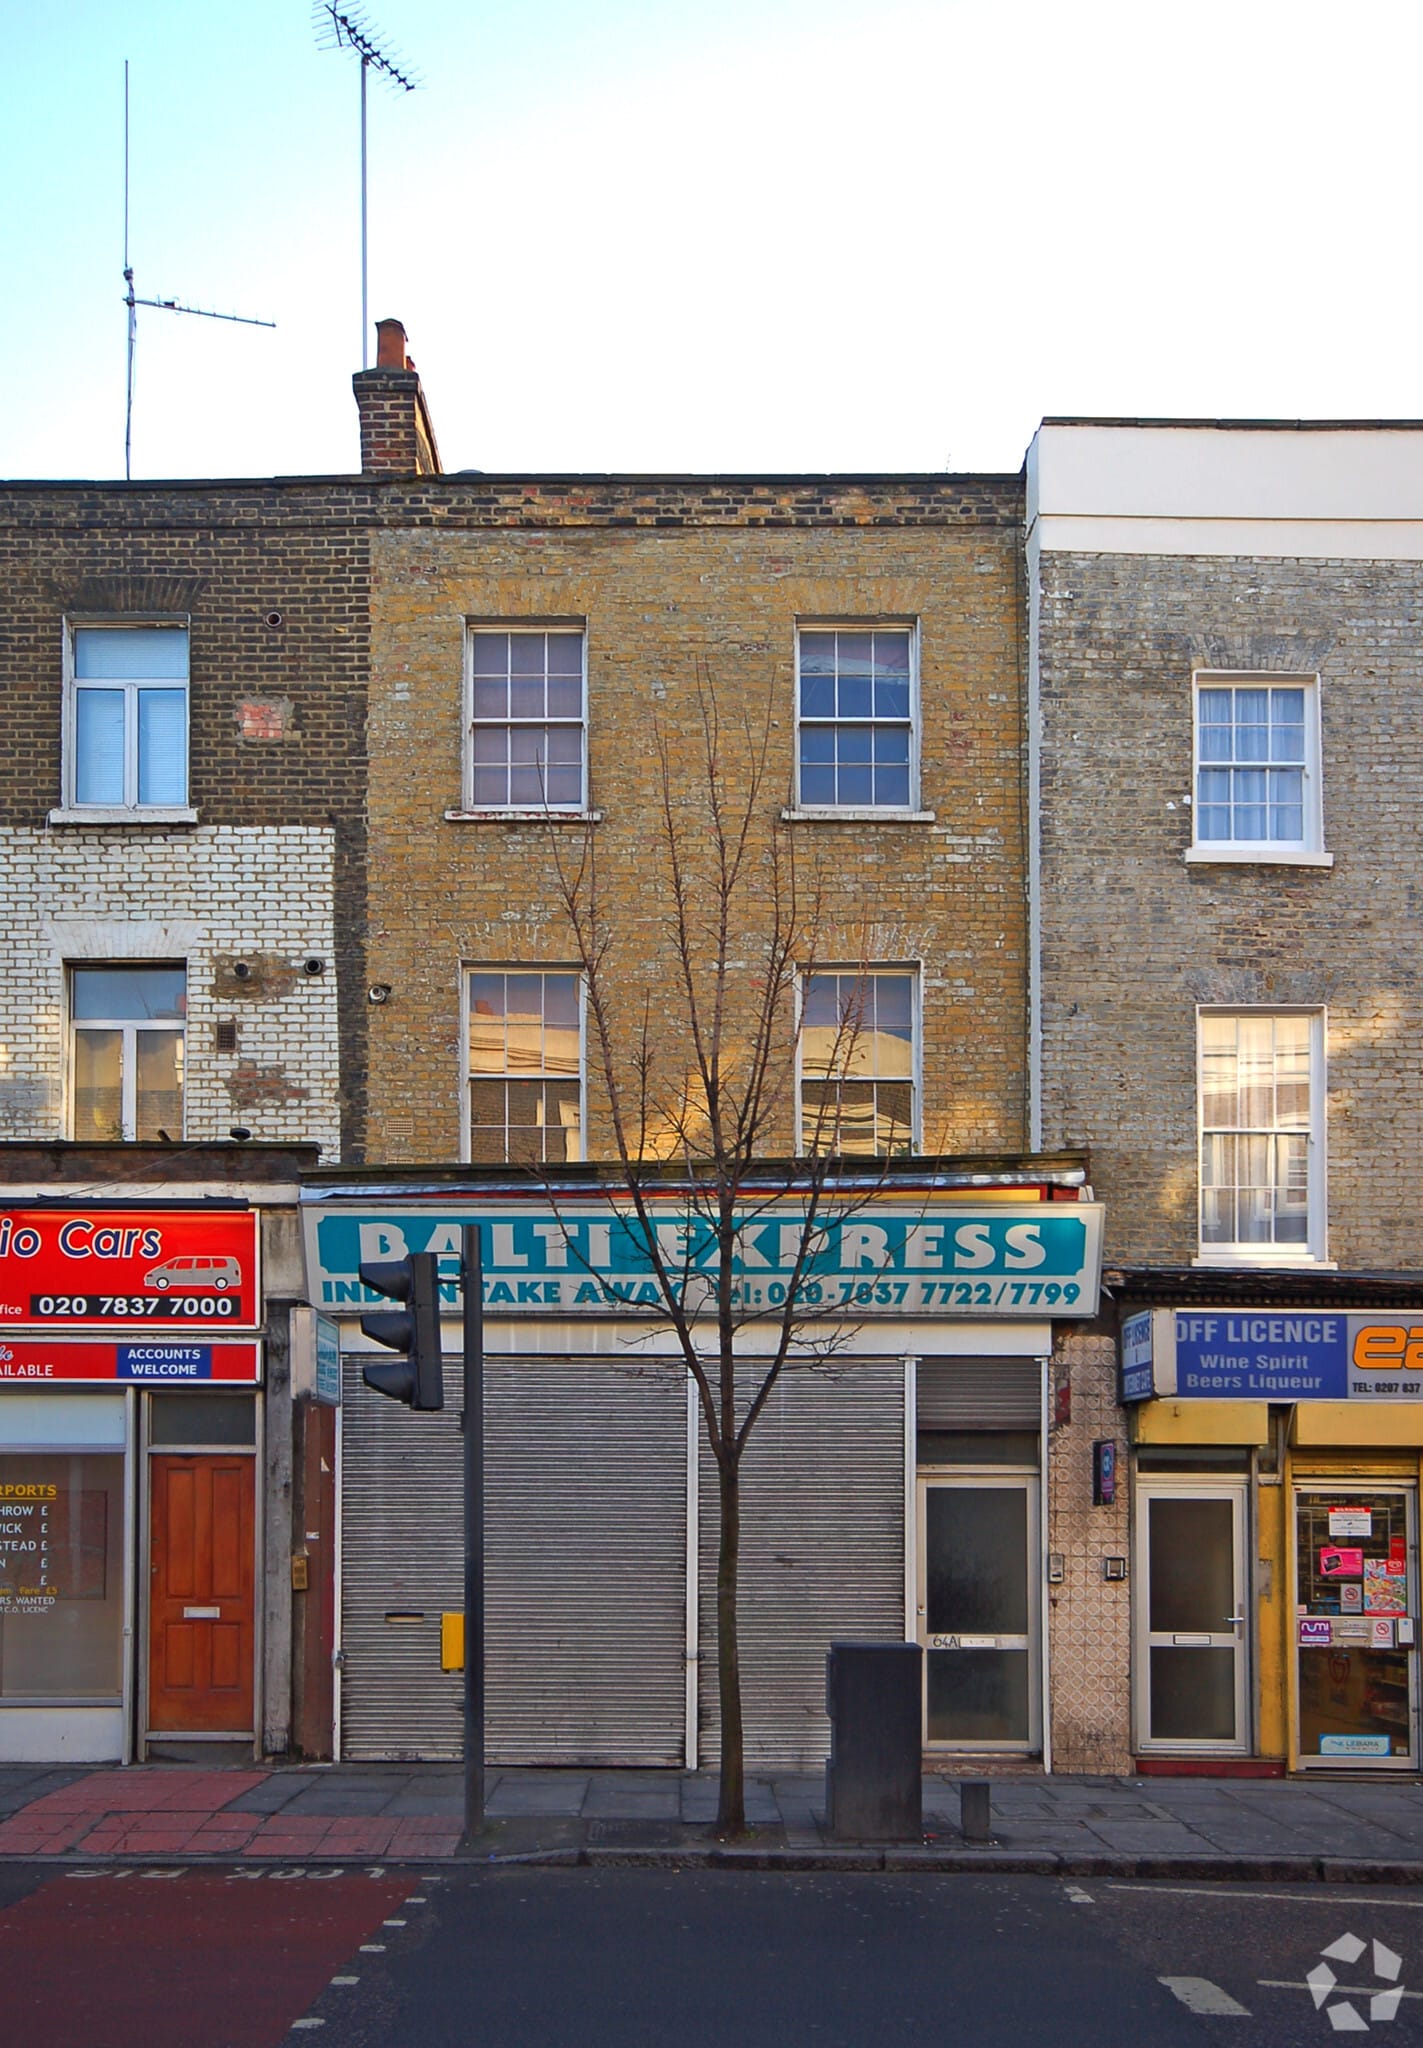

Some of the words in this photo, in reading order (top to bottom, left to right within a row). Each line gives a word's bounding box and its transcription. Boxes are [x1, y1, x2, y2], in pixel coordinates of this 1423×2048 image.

[58, 1219, 162, 1259] Cars
[359, 1223, 611, 1268] BALTI
[656, 1223, 1047, 1269] EXPRESS
[920, 1282, 1082, 1306] 7722/7799
[39, 1297, 87, 1315] 020
[99, 1297, 161, 1315] 7837
[169, 1297, 233, 1315] 7000
[1176, 1319, 1218, 1342] OFF
[1227, 1319, 1338, 1343] LICENCE
[127, 1348, 201, 1360] ACCOUNTS
[1199, 1354, 1249, 1369] Wine
[1256, 1354, 1309, 1371] Spirit
[131, 1364, 198, 1376] WELCOME
[1186, 1373, 1242, 1388] Beers
[1250, 1373, 1323, 1390] Liqueur
[1353, 1382, 1373, 1393] TEL:
[41, 1505, 49, 1516] £
[0, 1523, 22, 1534] ICK
[41, 1522, 49, 1534] £
[41, 1540, 49, 1551] £
[41, 1558, 48, 1569] £
[16, 1596, 56, 1605] WANTED
[933, 1635, 958, 1648] 64A
